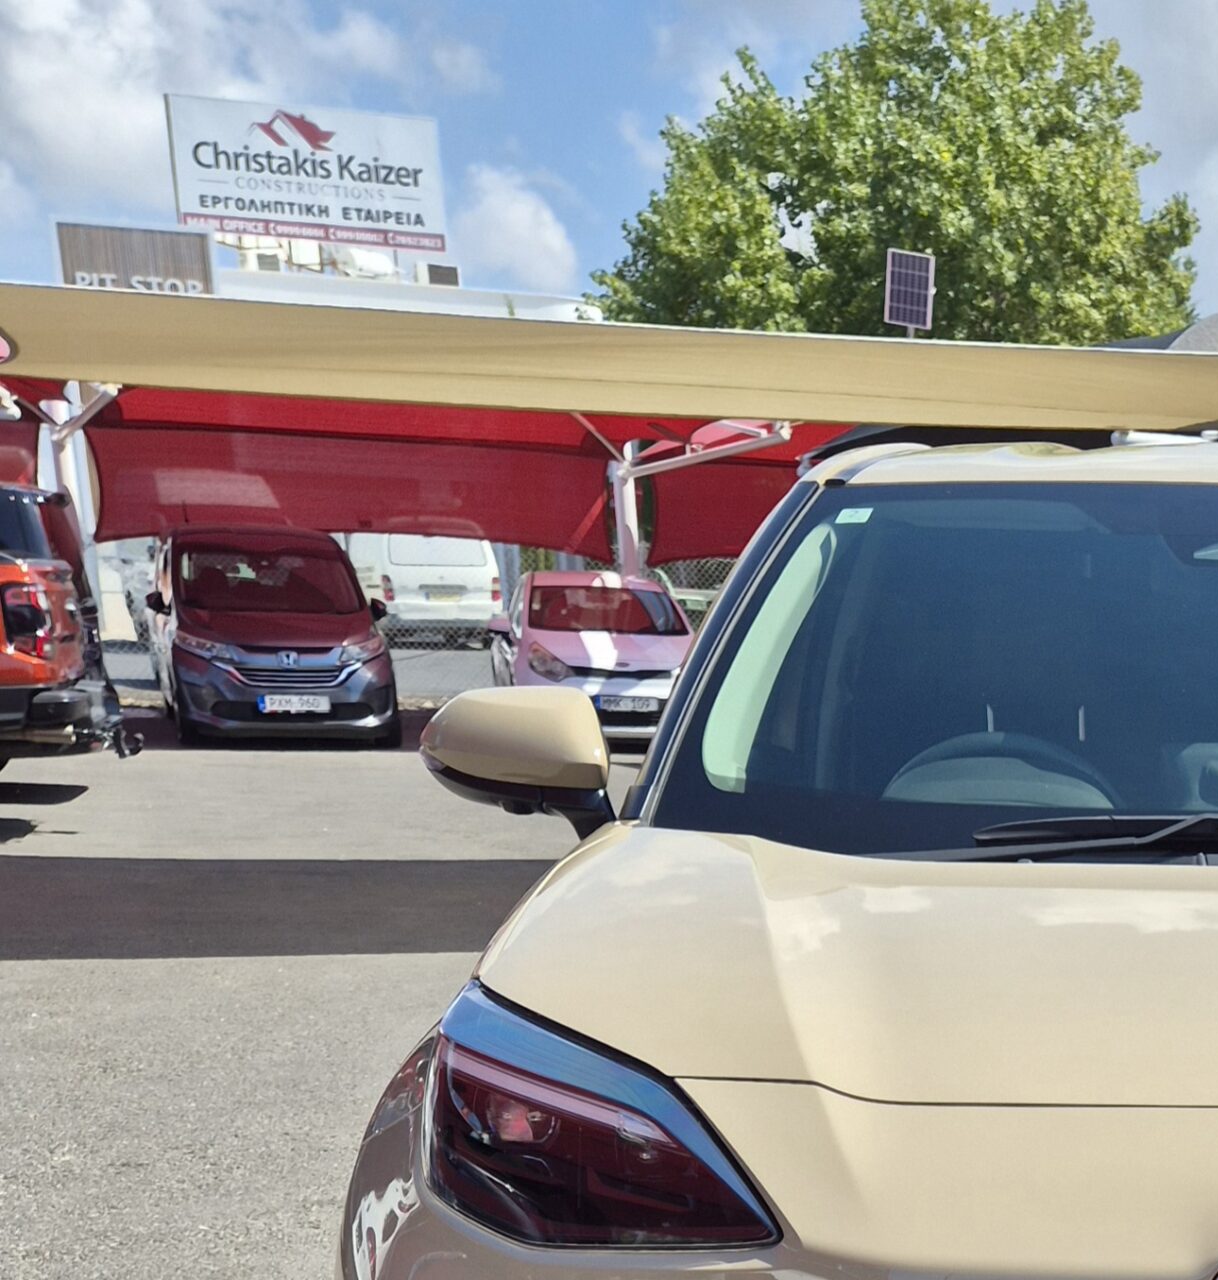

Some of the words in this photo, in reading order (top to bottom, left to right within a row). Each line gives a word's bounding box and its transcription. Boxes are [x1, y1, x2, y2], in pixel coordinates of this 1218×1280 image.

[192, 141, 332, 179] Christakis
[336, 154, 424, 188] Kaizer
[235, 176, 386, 202] CONSTRUCTIONS
[198, 194, 330, 218] ΕΡΓΟΛΗΠΤΙΚΗ
[342, 206, 426, 228] ΕΤΑΙΡΕΙΑ
[74, 271, 117, 289] PIT
[130, 275, 204, 294] STOP
